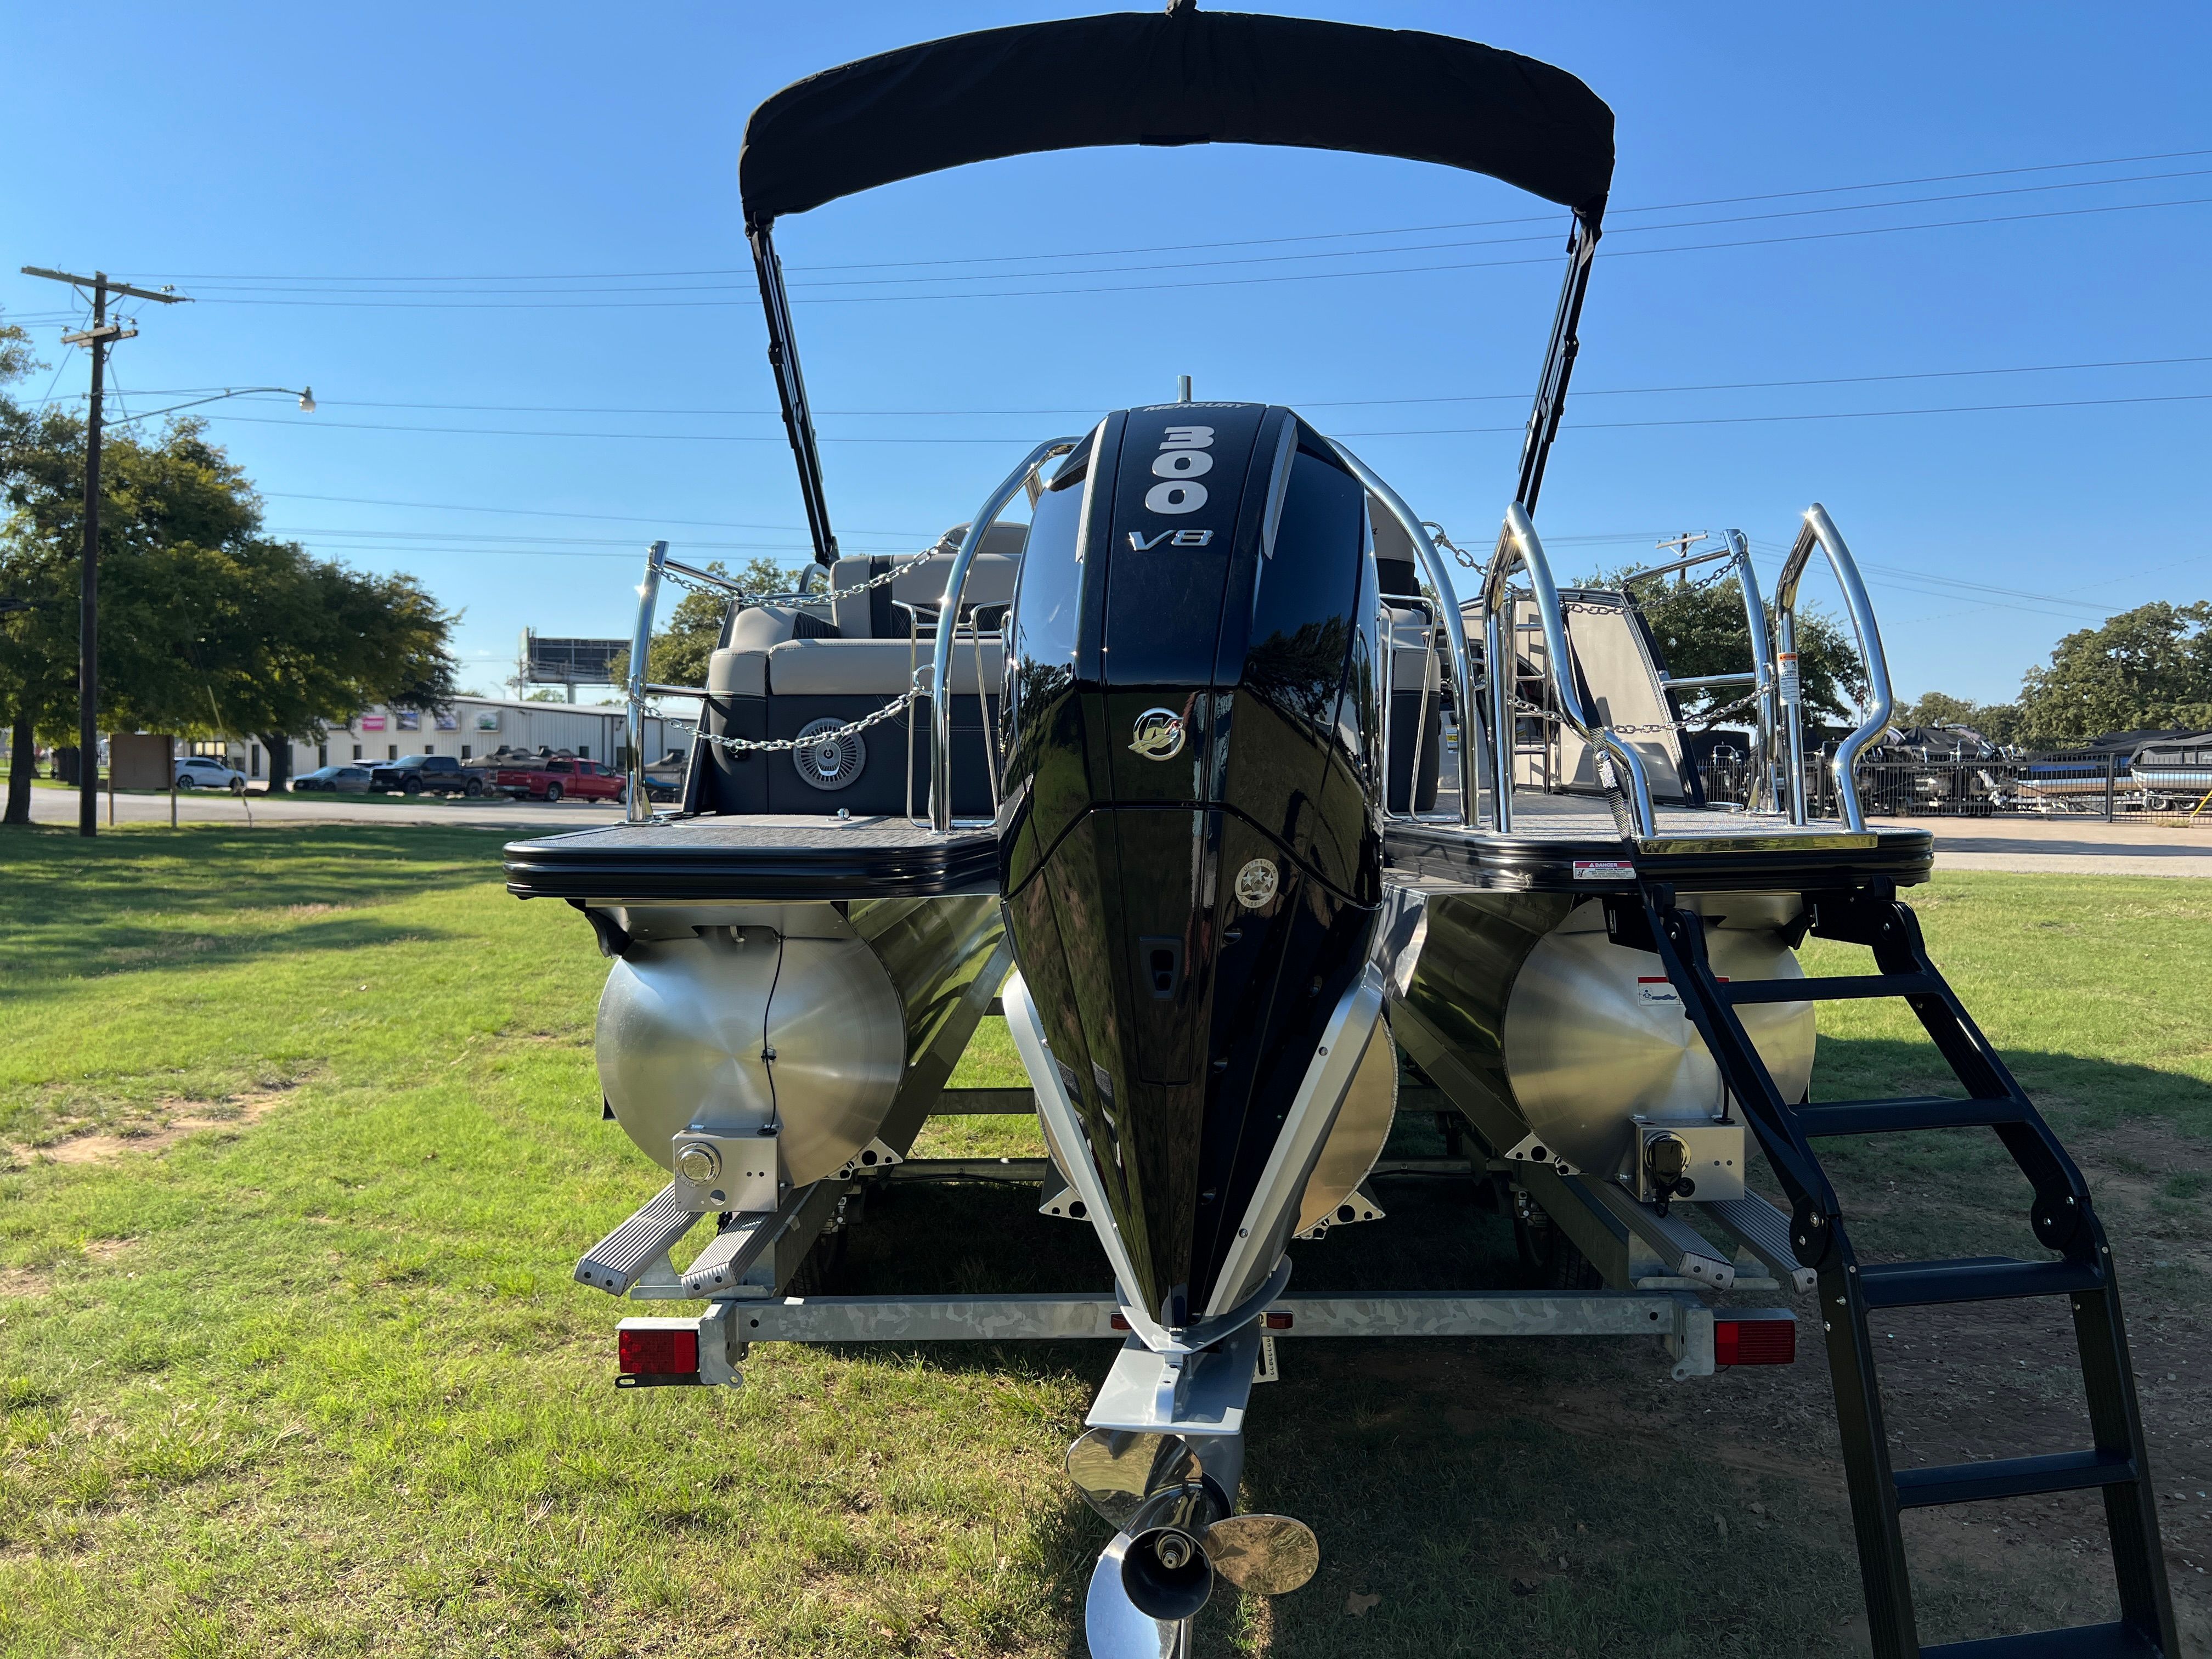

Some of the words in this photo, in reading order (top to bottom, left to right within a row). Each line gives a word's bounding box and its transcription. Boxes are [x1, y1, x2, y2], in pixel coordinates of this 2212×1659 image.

[1143, 403, 1250, 411] MERCURY
[1145, 426, 1215, 514] 300
[1128, 529, 1214, 551] V8
